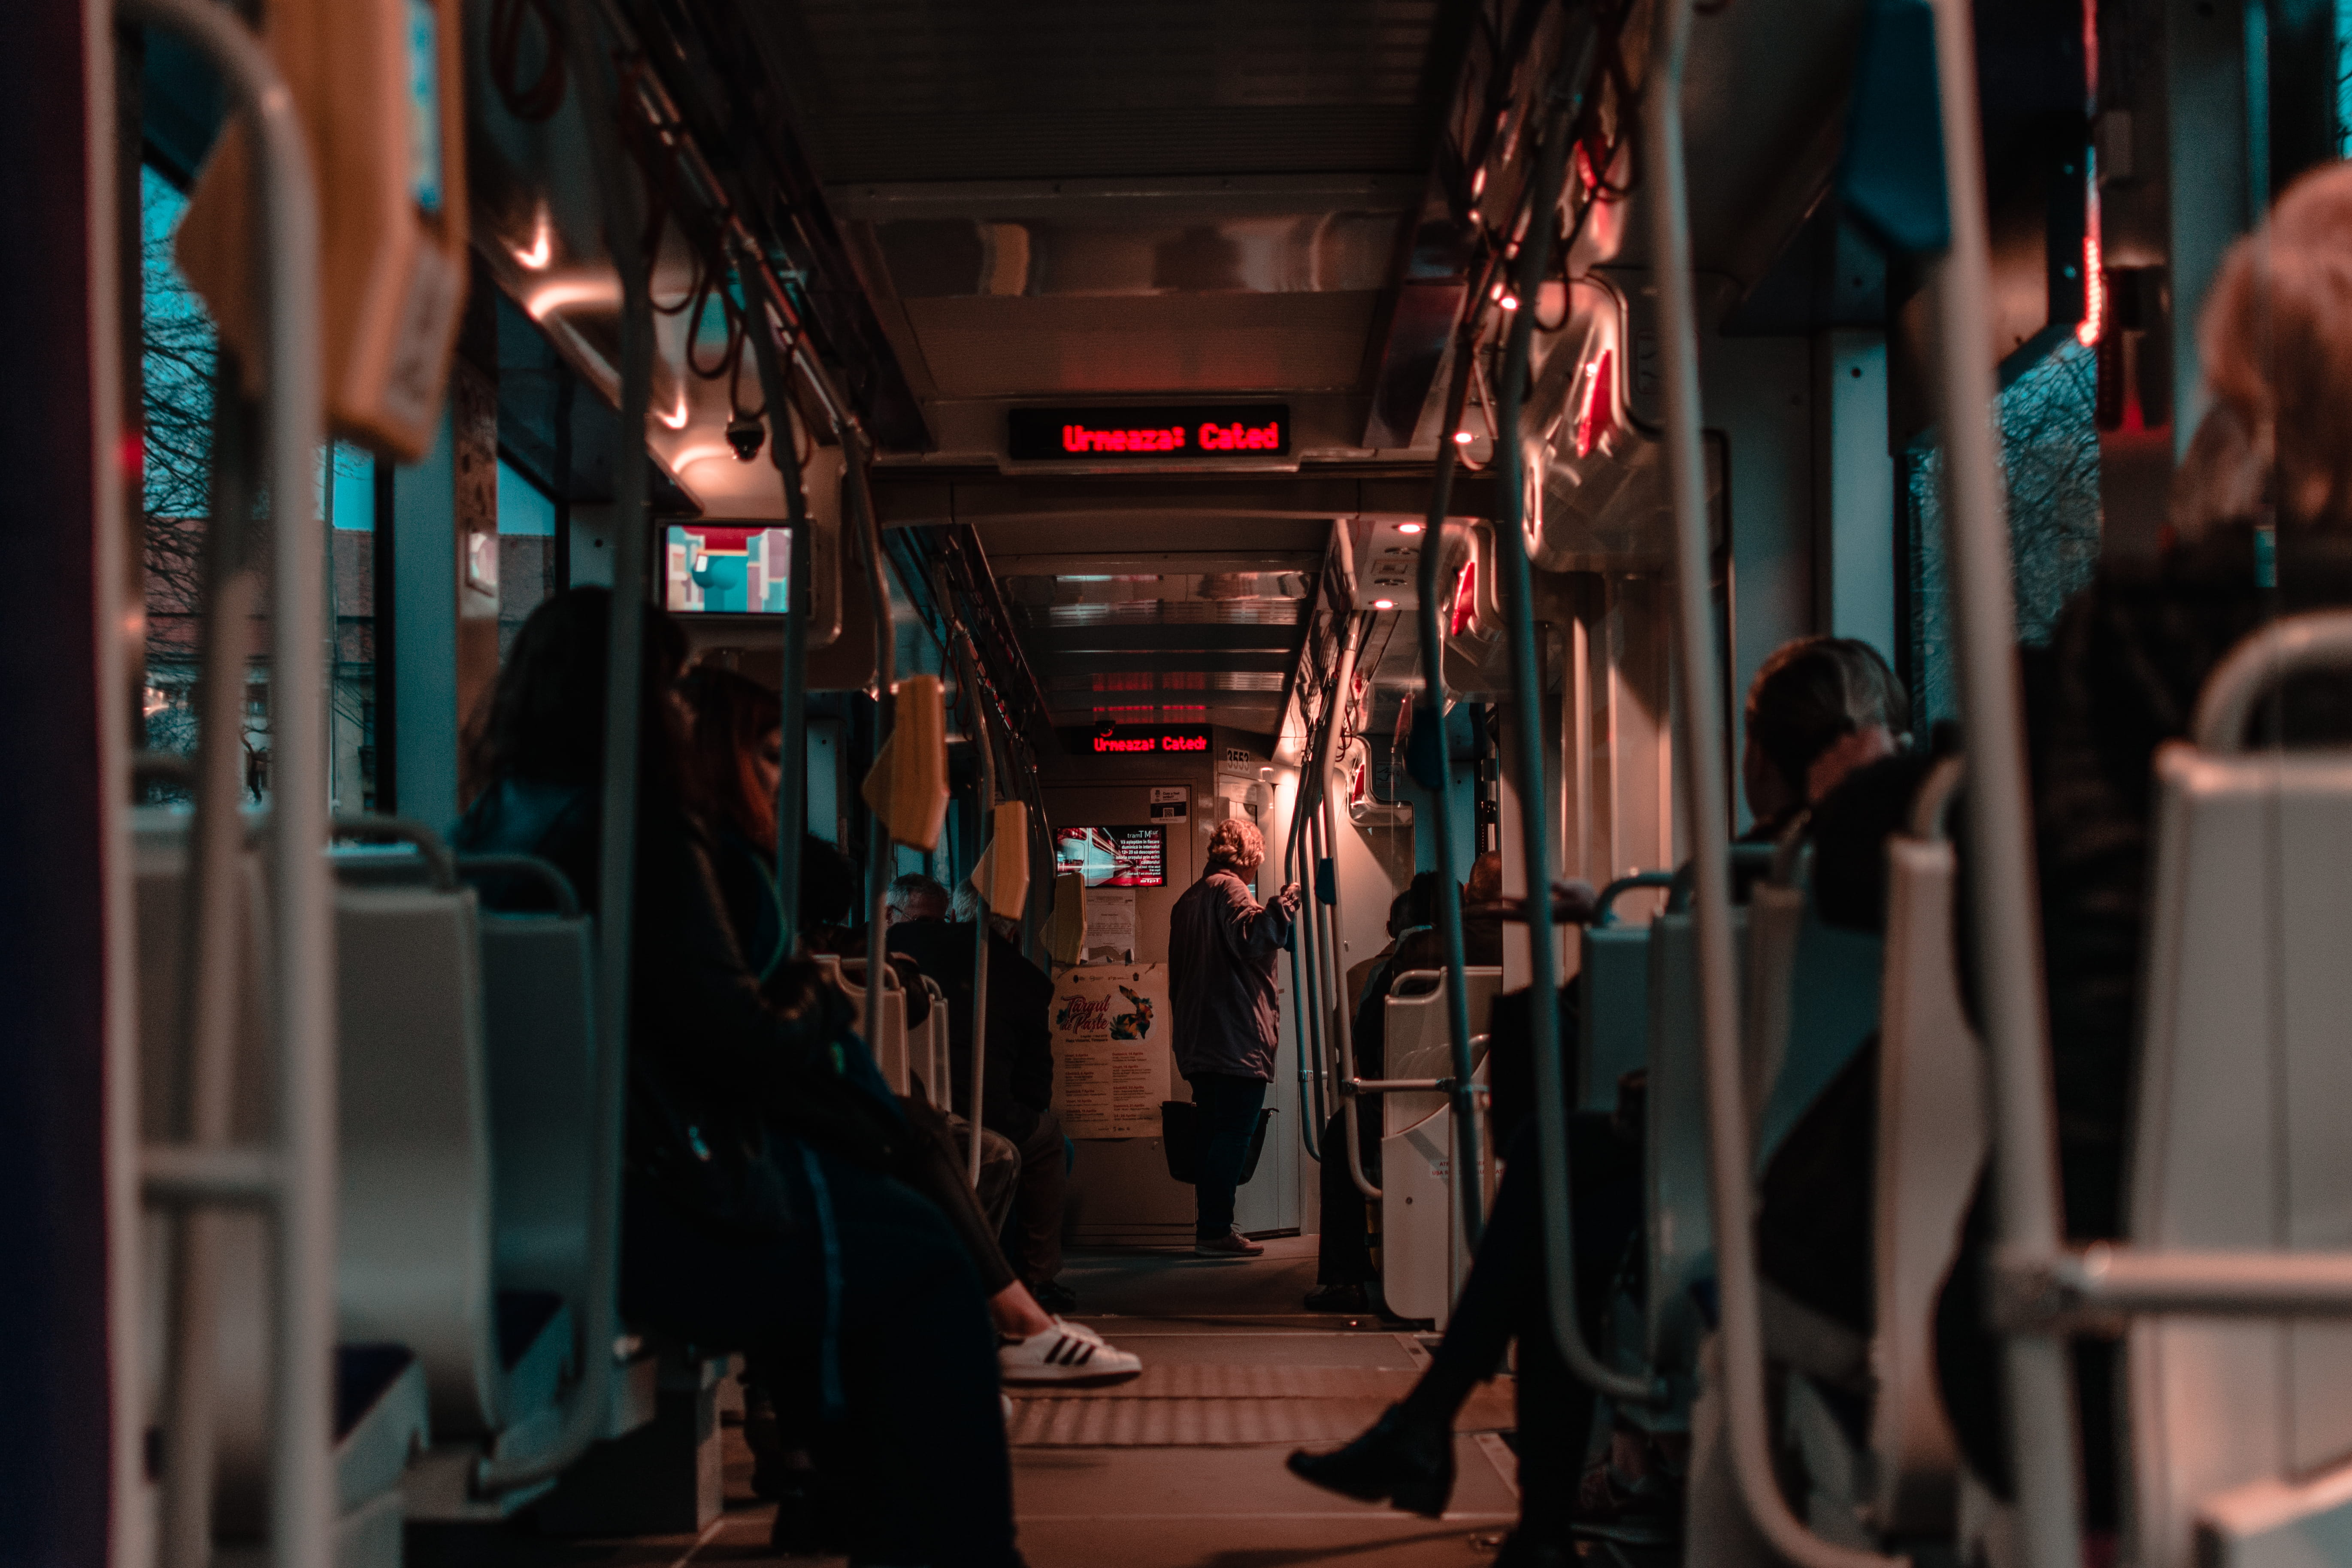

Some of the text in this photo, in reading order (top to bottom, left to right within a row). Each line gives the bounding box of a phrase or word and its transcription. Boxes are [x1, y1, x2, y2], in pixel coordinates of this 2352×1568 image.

[1199, 422, 1278, 450] Cated
[1094, 738, 1154, 751] Urmeaza:
[1228, 750, 1249, 771] 3553
[1061, 994, 1111, 1018] Târgul
[1060, 1018, 1072, 1031] de
